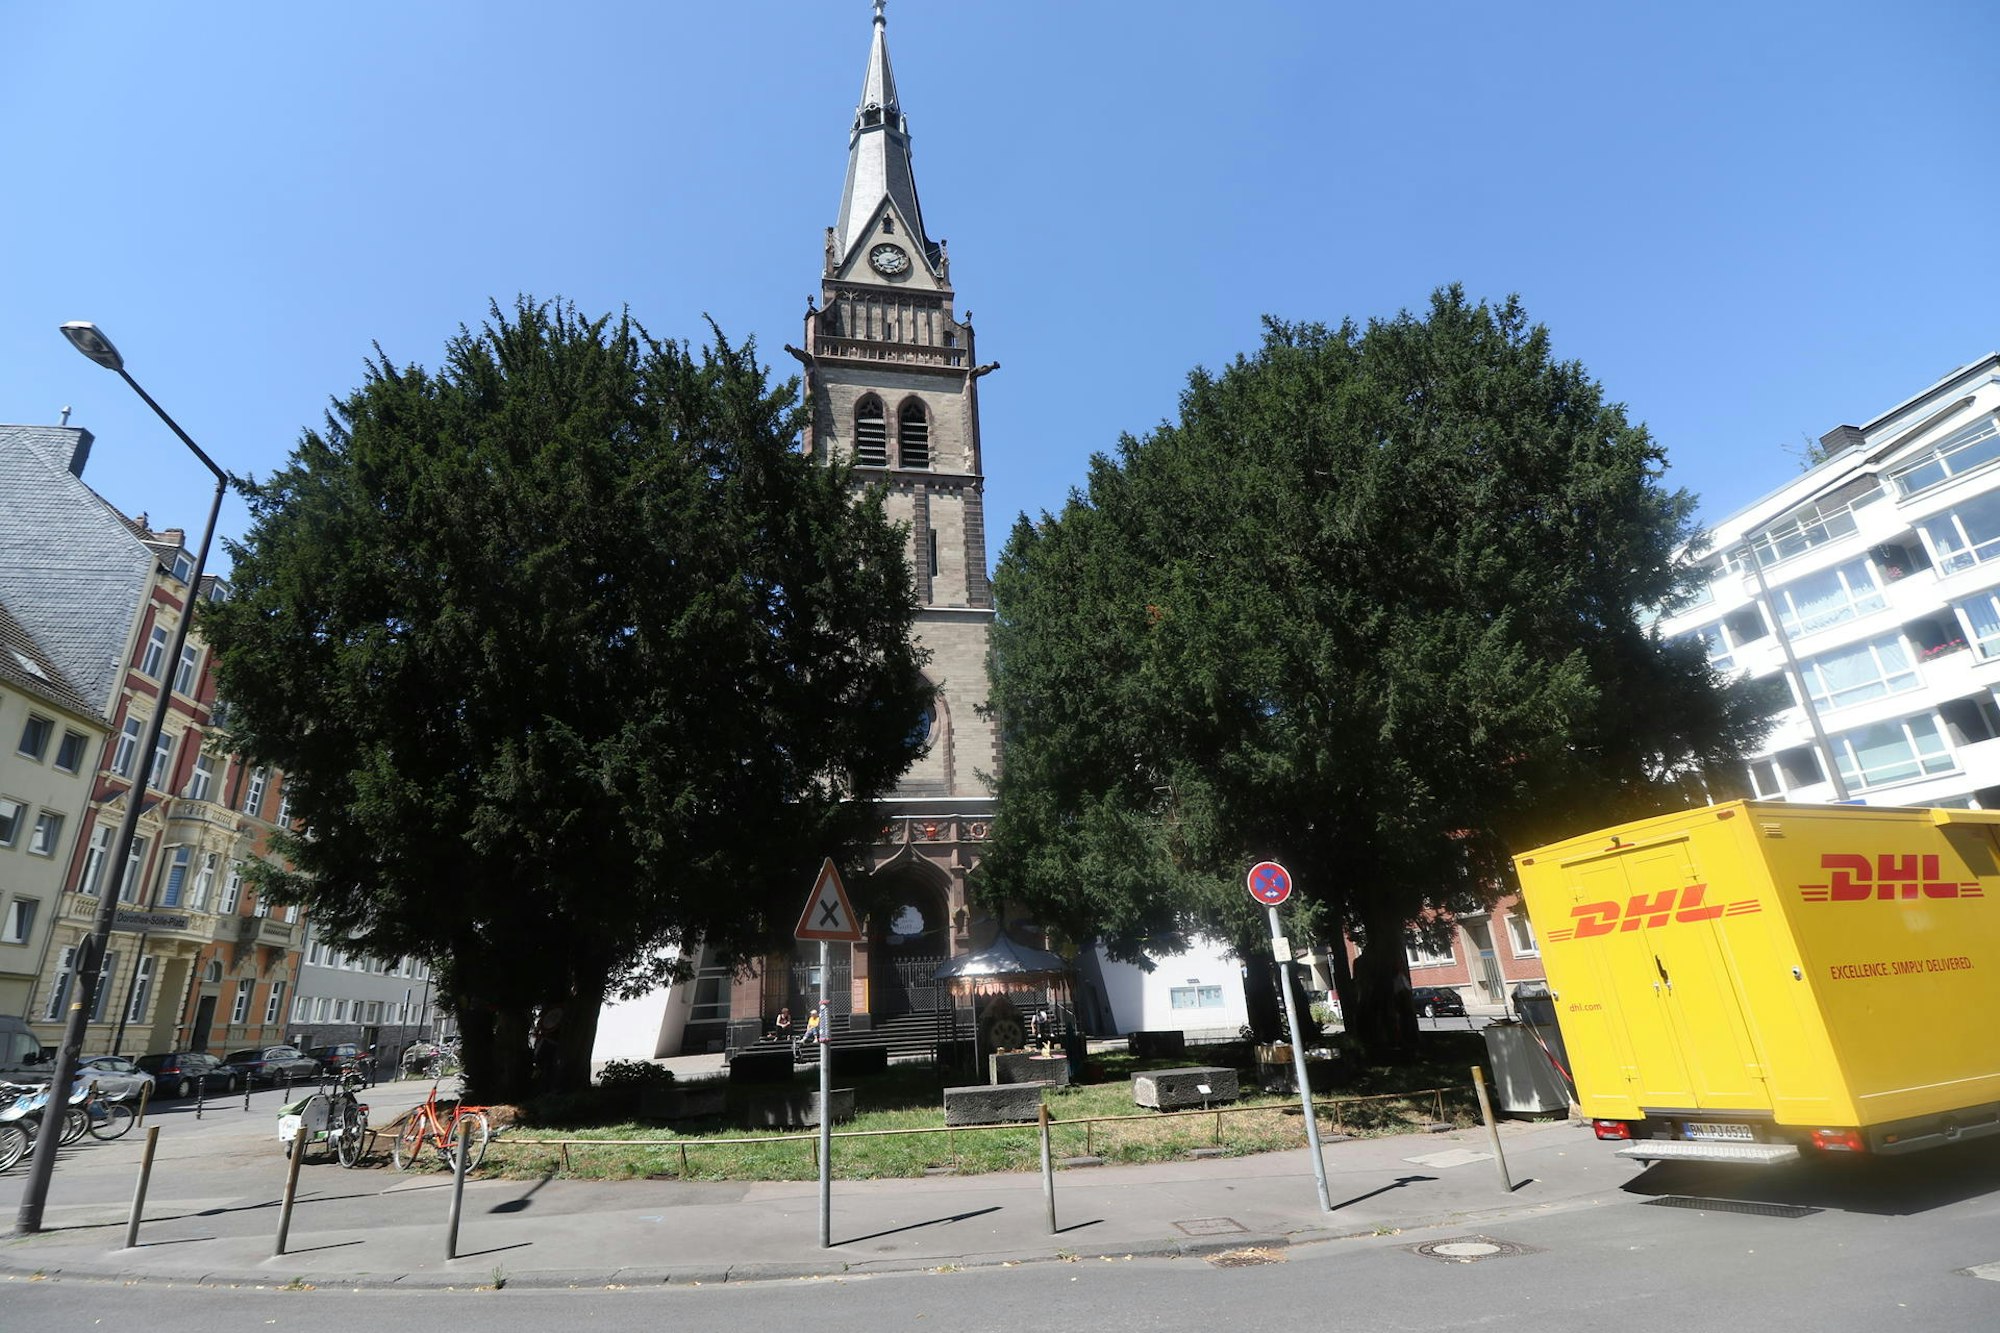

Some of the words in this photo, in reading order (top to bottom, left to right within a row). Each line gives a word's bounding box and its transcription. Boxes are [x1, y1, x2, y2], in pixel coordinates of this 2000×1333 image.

[1820, 853, 1959, 901] DHL
[1569, 883, 1726, 940] DHL
[1830, 962, 1892, 980] EXCELLENCE.
[1891, 960, 1924, 975] SIMPLY
[1925, 956, 1975, 972] DELIVERED.
[1569, 1002, 1602, 1012] dhl.com
